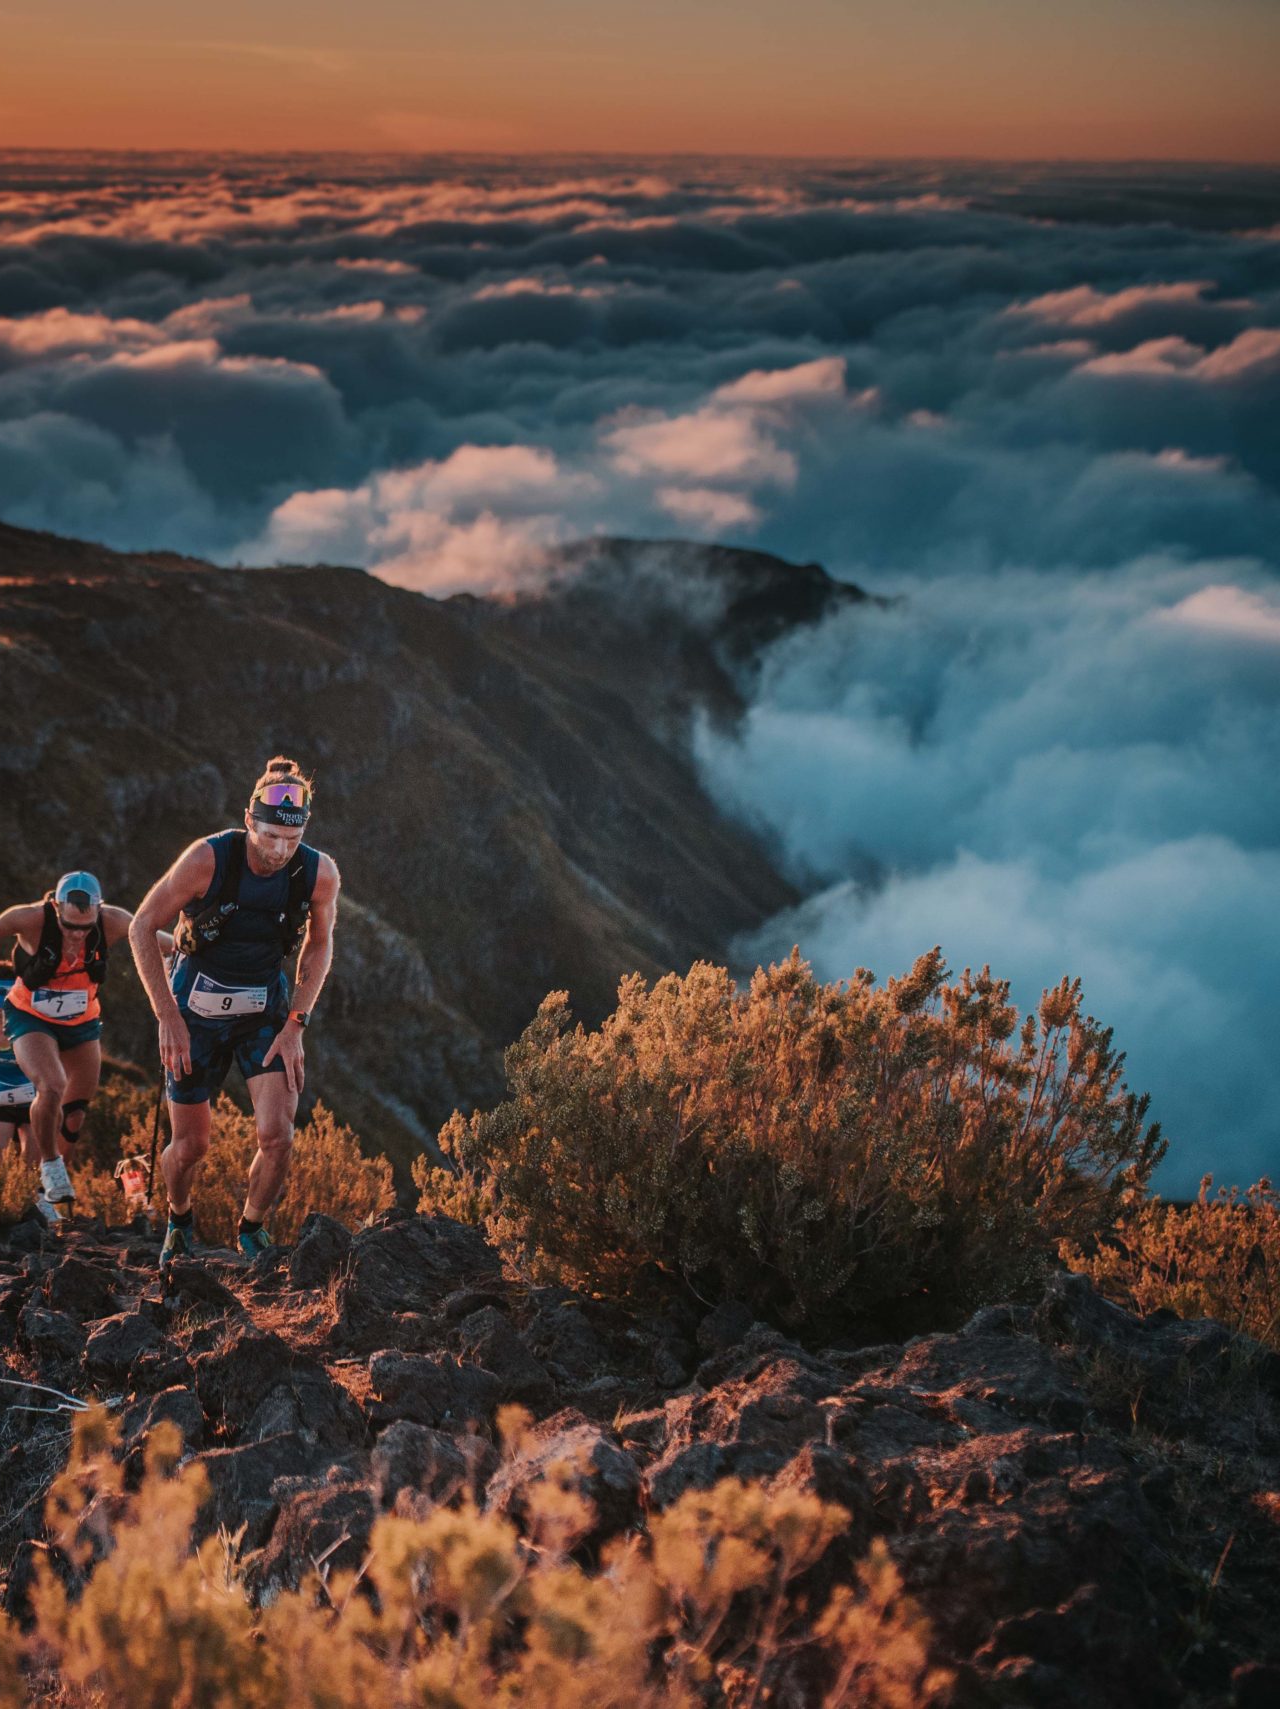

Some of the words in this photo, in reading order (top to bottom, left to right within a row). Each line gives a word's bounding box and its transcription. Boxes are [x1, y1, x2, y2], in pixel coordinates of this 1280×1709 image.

[276, 809, 303, 821] Sports
[56, 1000, 64, 1013] 7
[221, 996, 233, 1011] 9
[7, 1092, 15, 1103] 5
